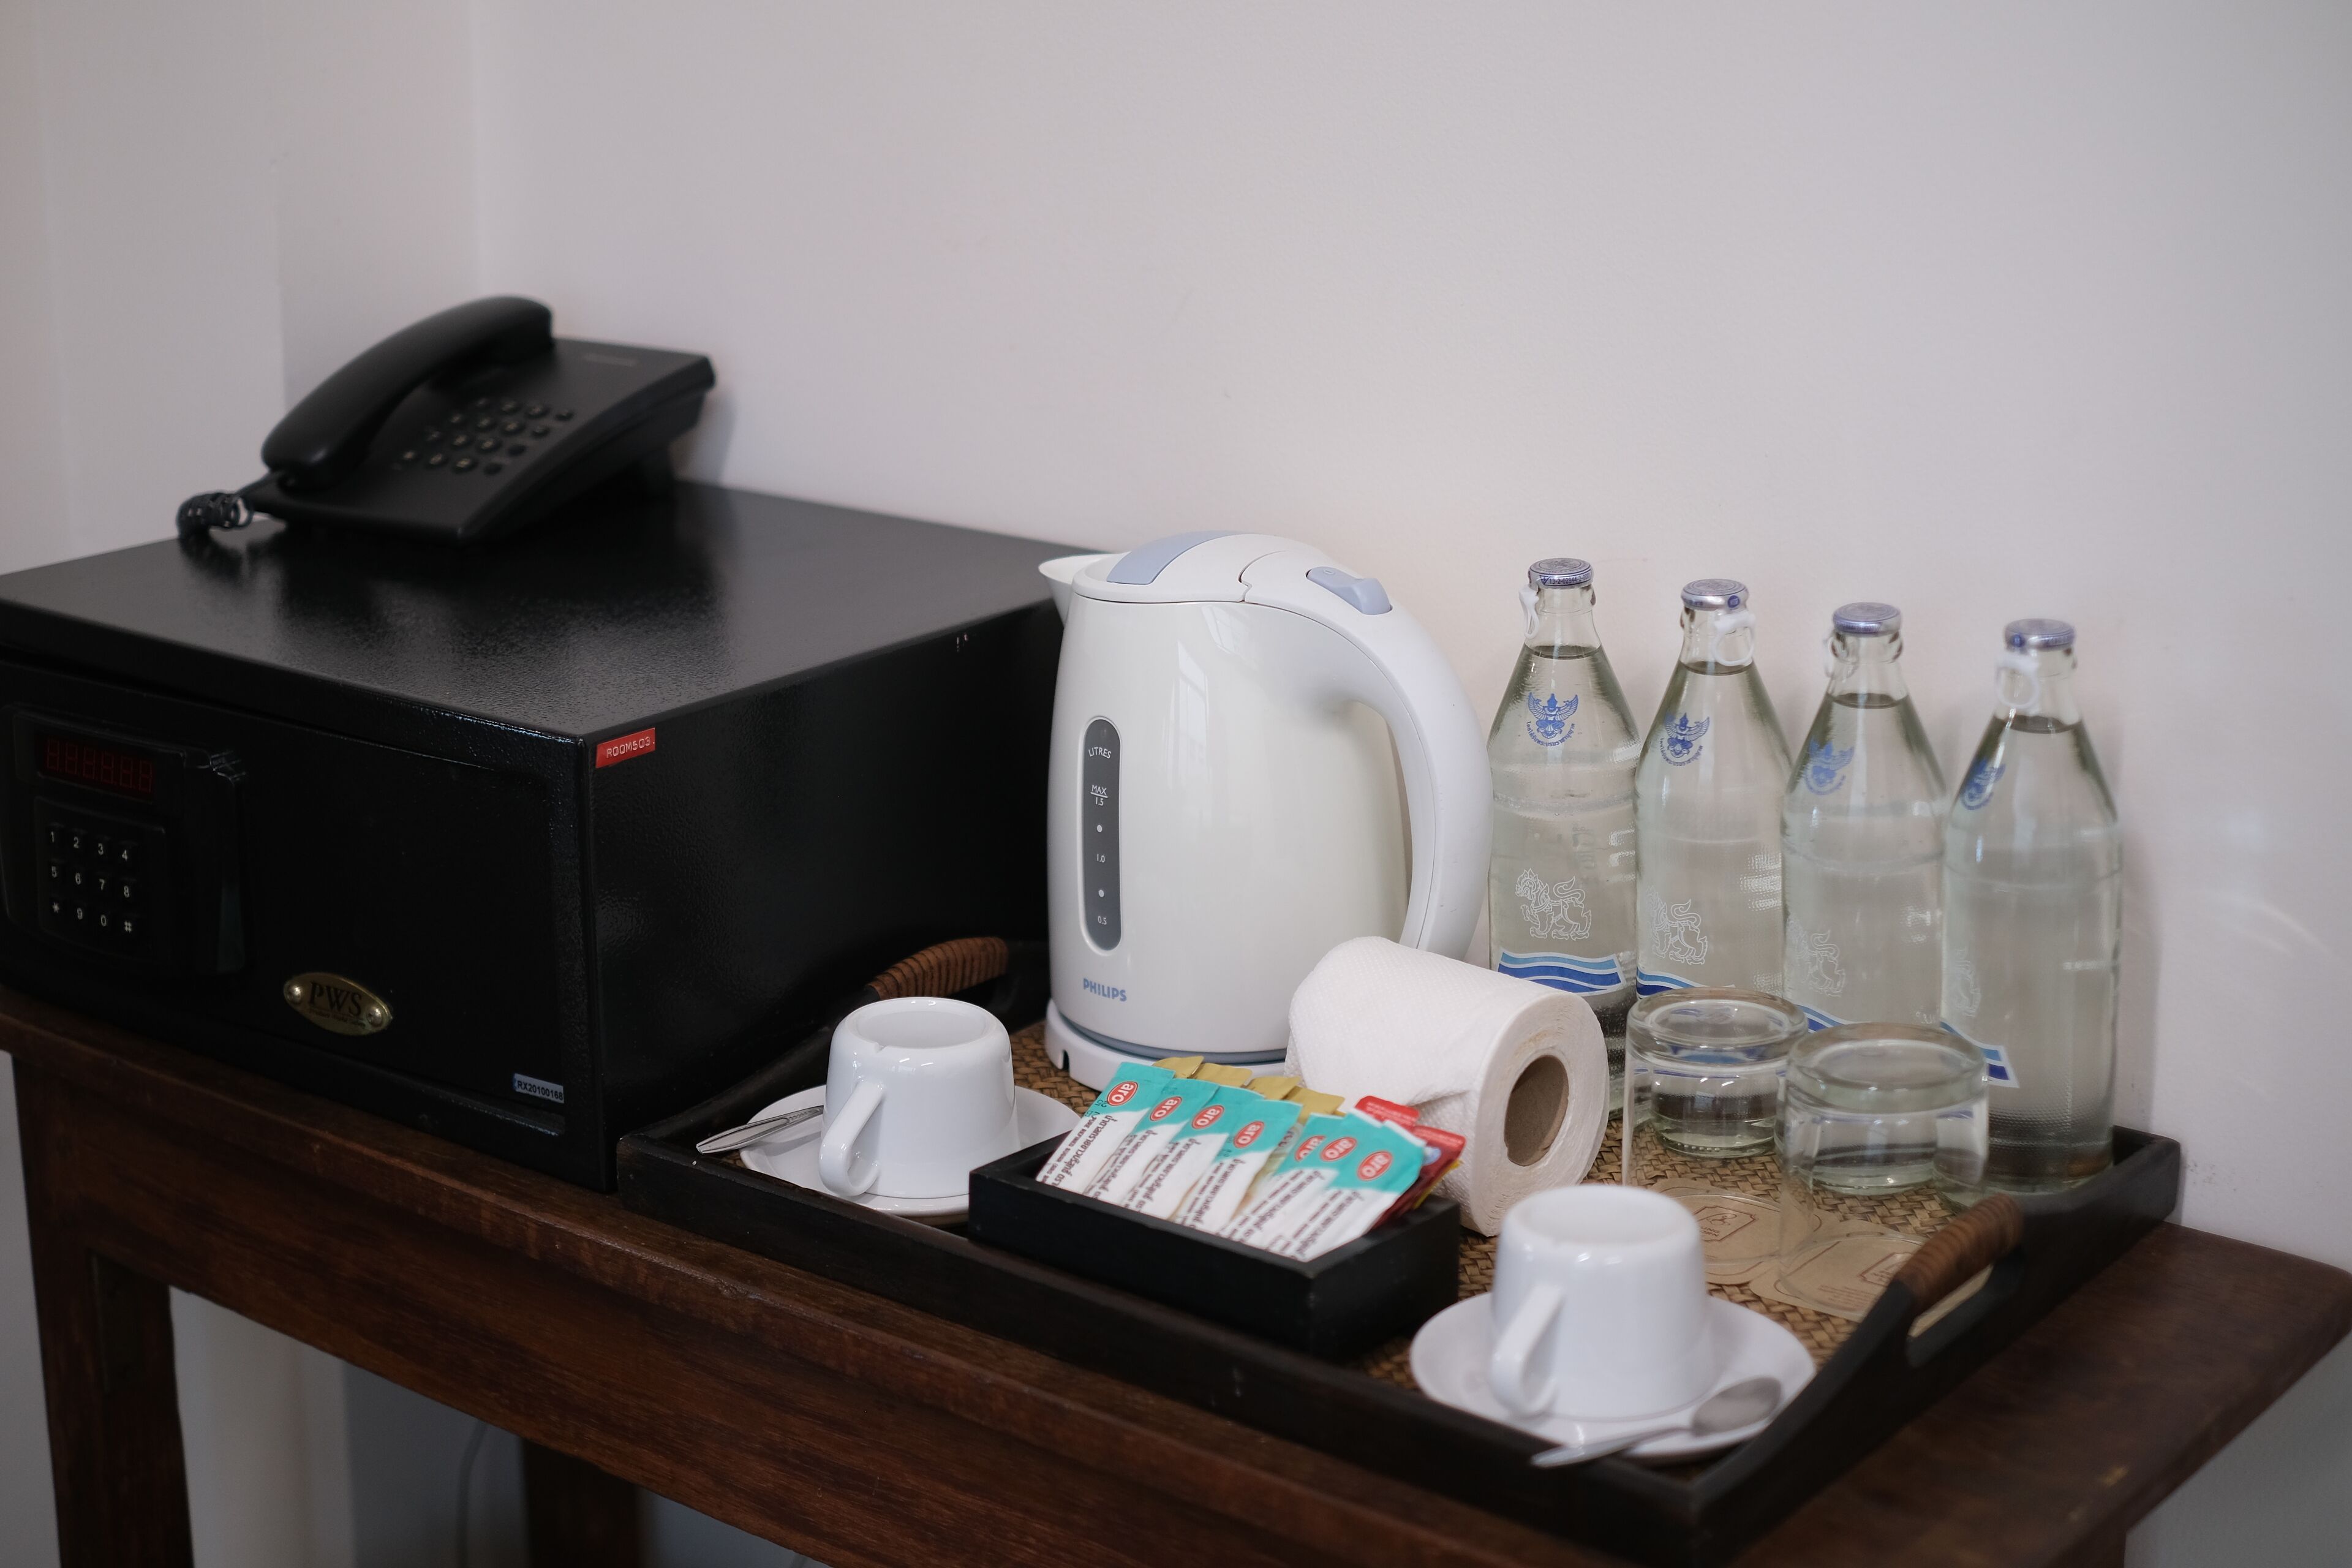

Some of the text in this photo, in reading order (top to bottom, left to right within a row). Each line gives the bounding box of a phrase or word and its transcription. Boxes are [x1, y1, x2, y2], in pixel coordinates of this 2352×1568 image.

[1088, 747, 1112, 759] LITRES
[1091, 784, 1107, 796] MAX
[1095, 797, 1104, 806] 1.5
[50, 831, 129, 862] 1 2 3 4
[1096, 854, 1106, 863] 1.0
[51, 865, 130, 898] 5 6 7 8
[77, 907, 84, 920] 9
[100, 914, 107, 927] 0
[1098, 916, 1107, 925] 0.5
[308, 981, 363, 1017] PWS
[1083, 978, 1127, 1002] PHILIPS
[517, 1080, 563, 1101] RX20100168
[1112, 1083, 1134, 1102] aro
[1155, 1098, 1178, 1117] aro
[1198, 1106, 1220, 1125] aro
[1238, 1123, 1261, 1144] aro
[1324, 1139, 1351, 1158] aro
[1361, 1153, 1389, 1176] aro
